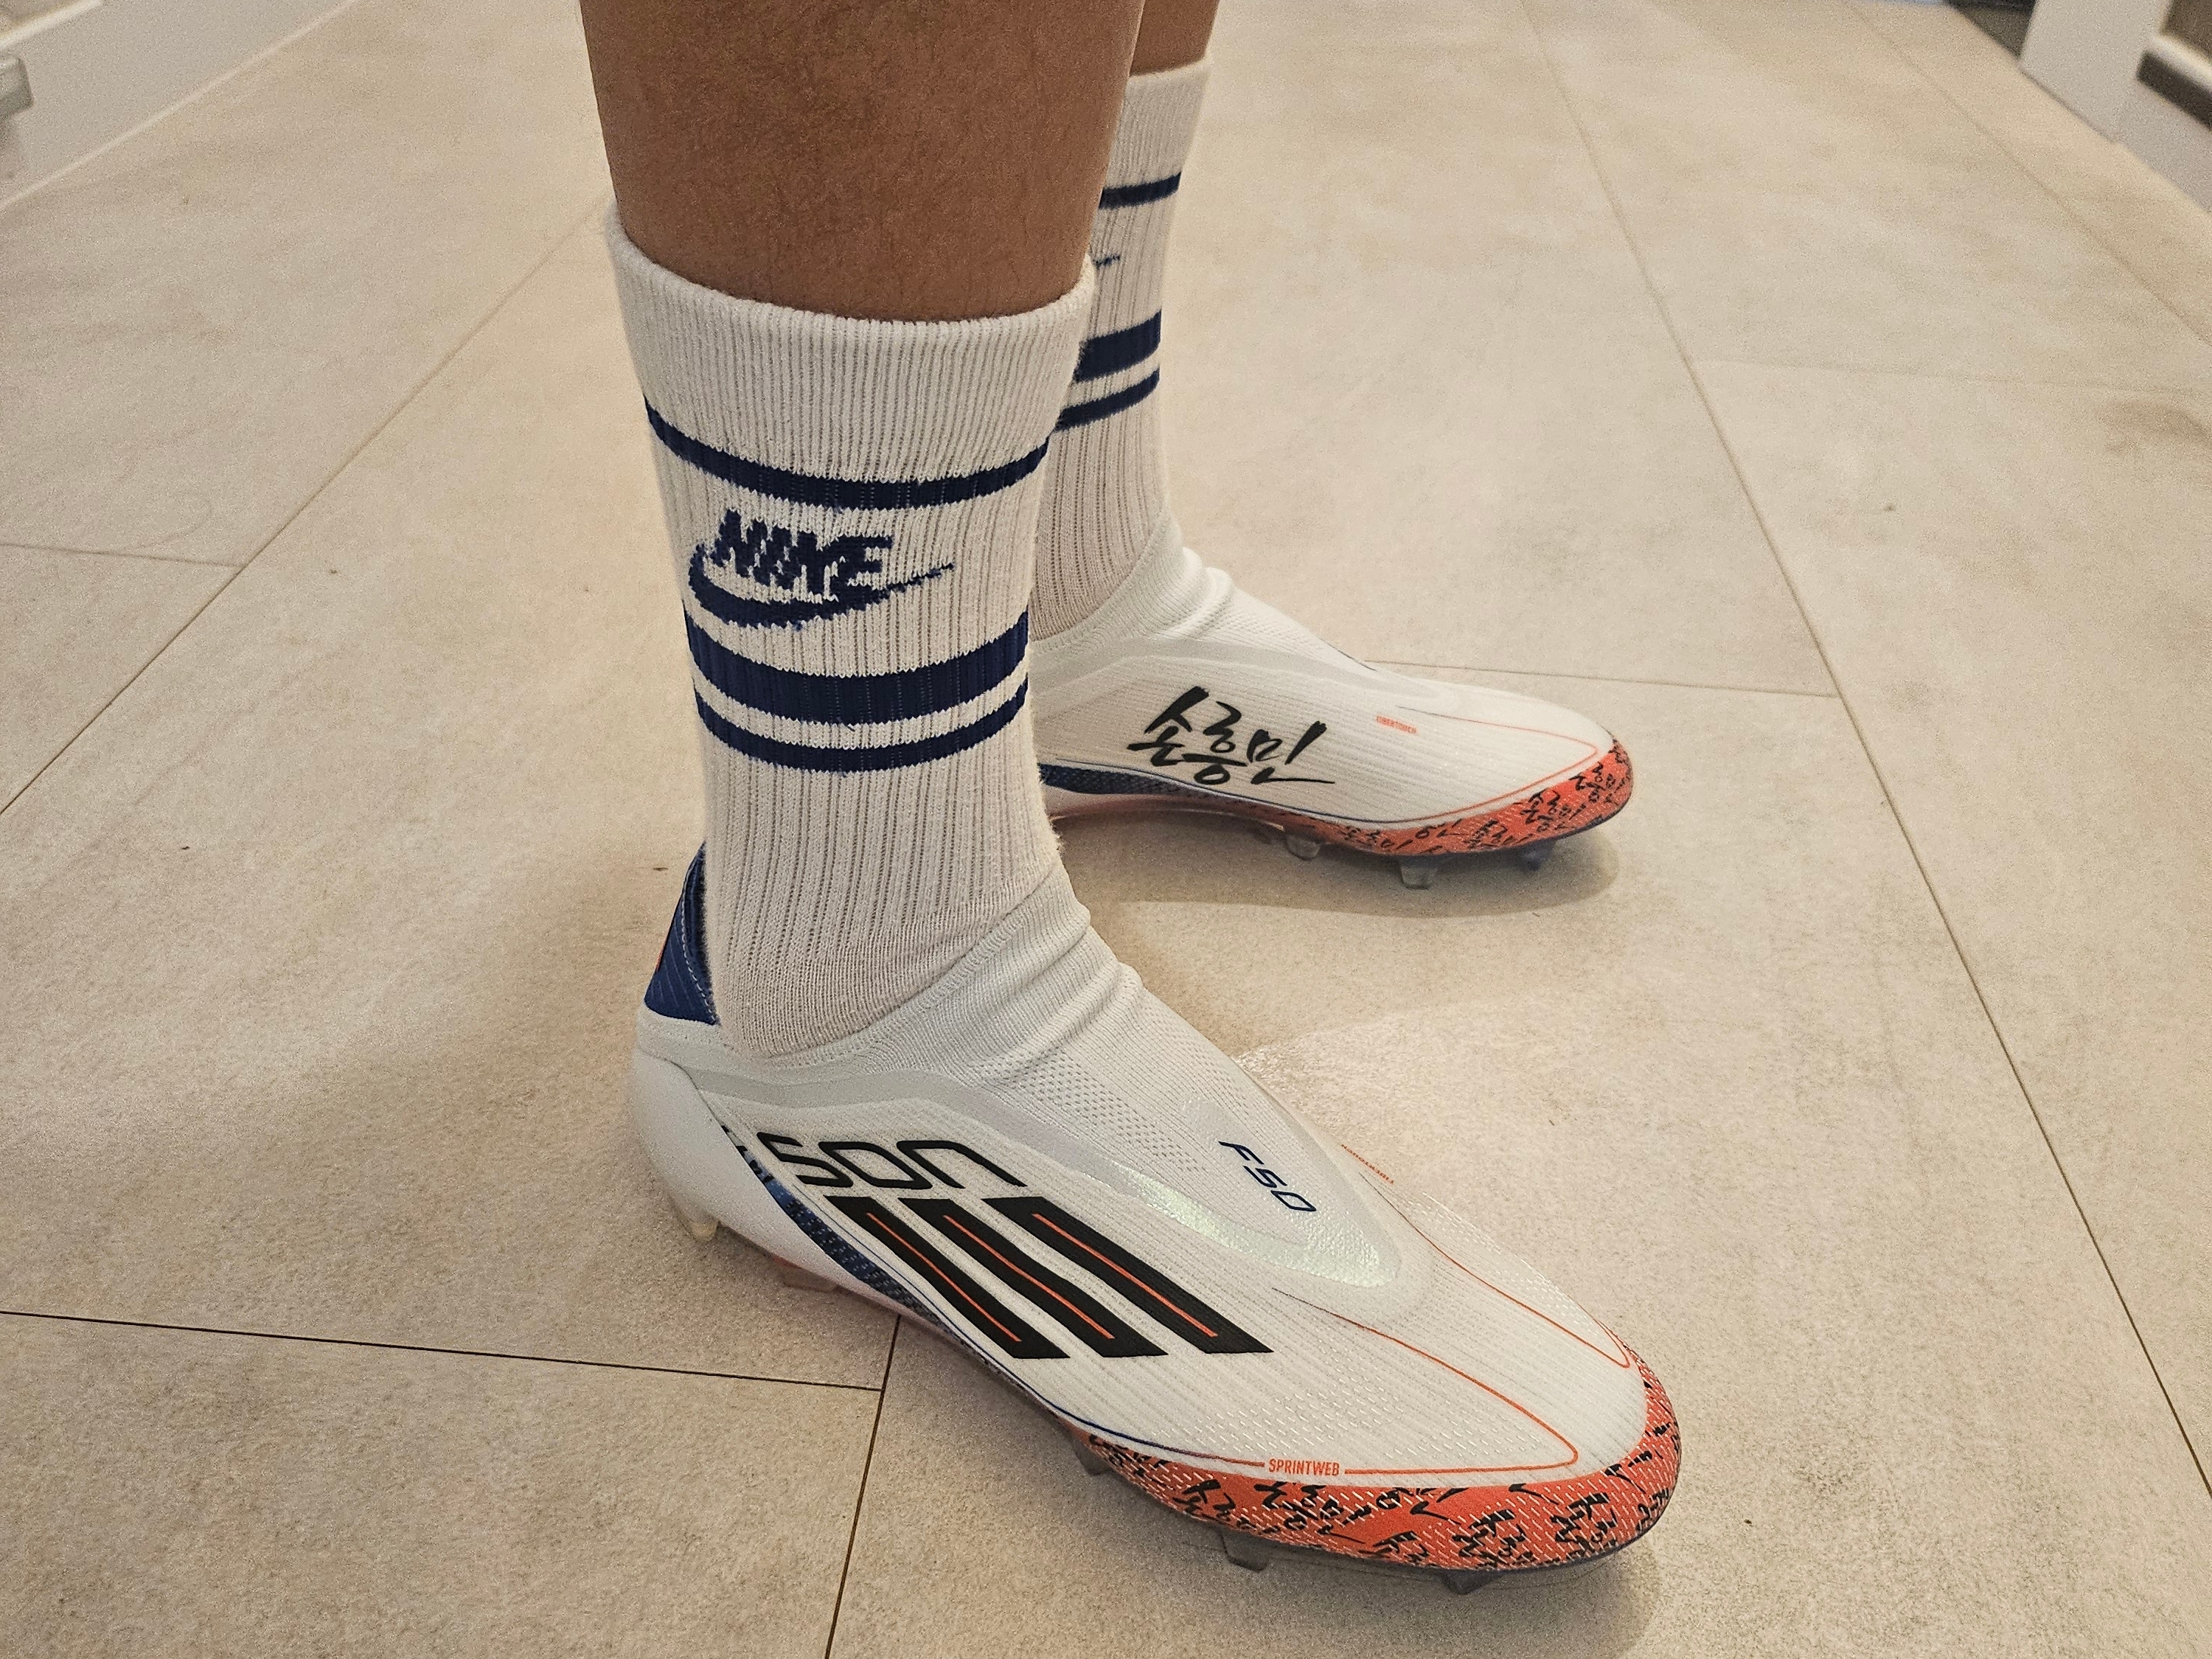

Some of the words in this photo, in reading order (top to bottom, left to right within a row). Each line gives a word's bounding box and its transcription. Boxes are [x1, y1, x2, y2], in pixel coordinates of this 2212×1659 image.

[710, 507, 894, 600] NIKE
[1127, 685, 1336, 785] 손흥민
[1218, 1141, 1317, 1211] F50
[1268, 1458, 1340, 1476] SPRINTWEB
